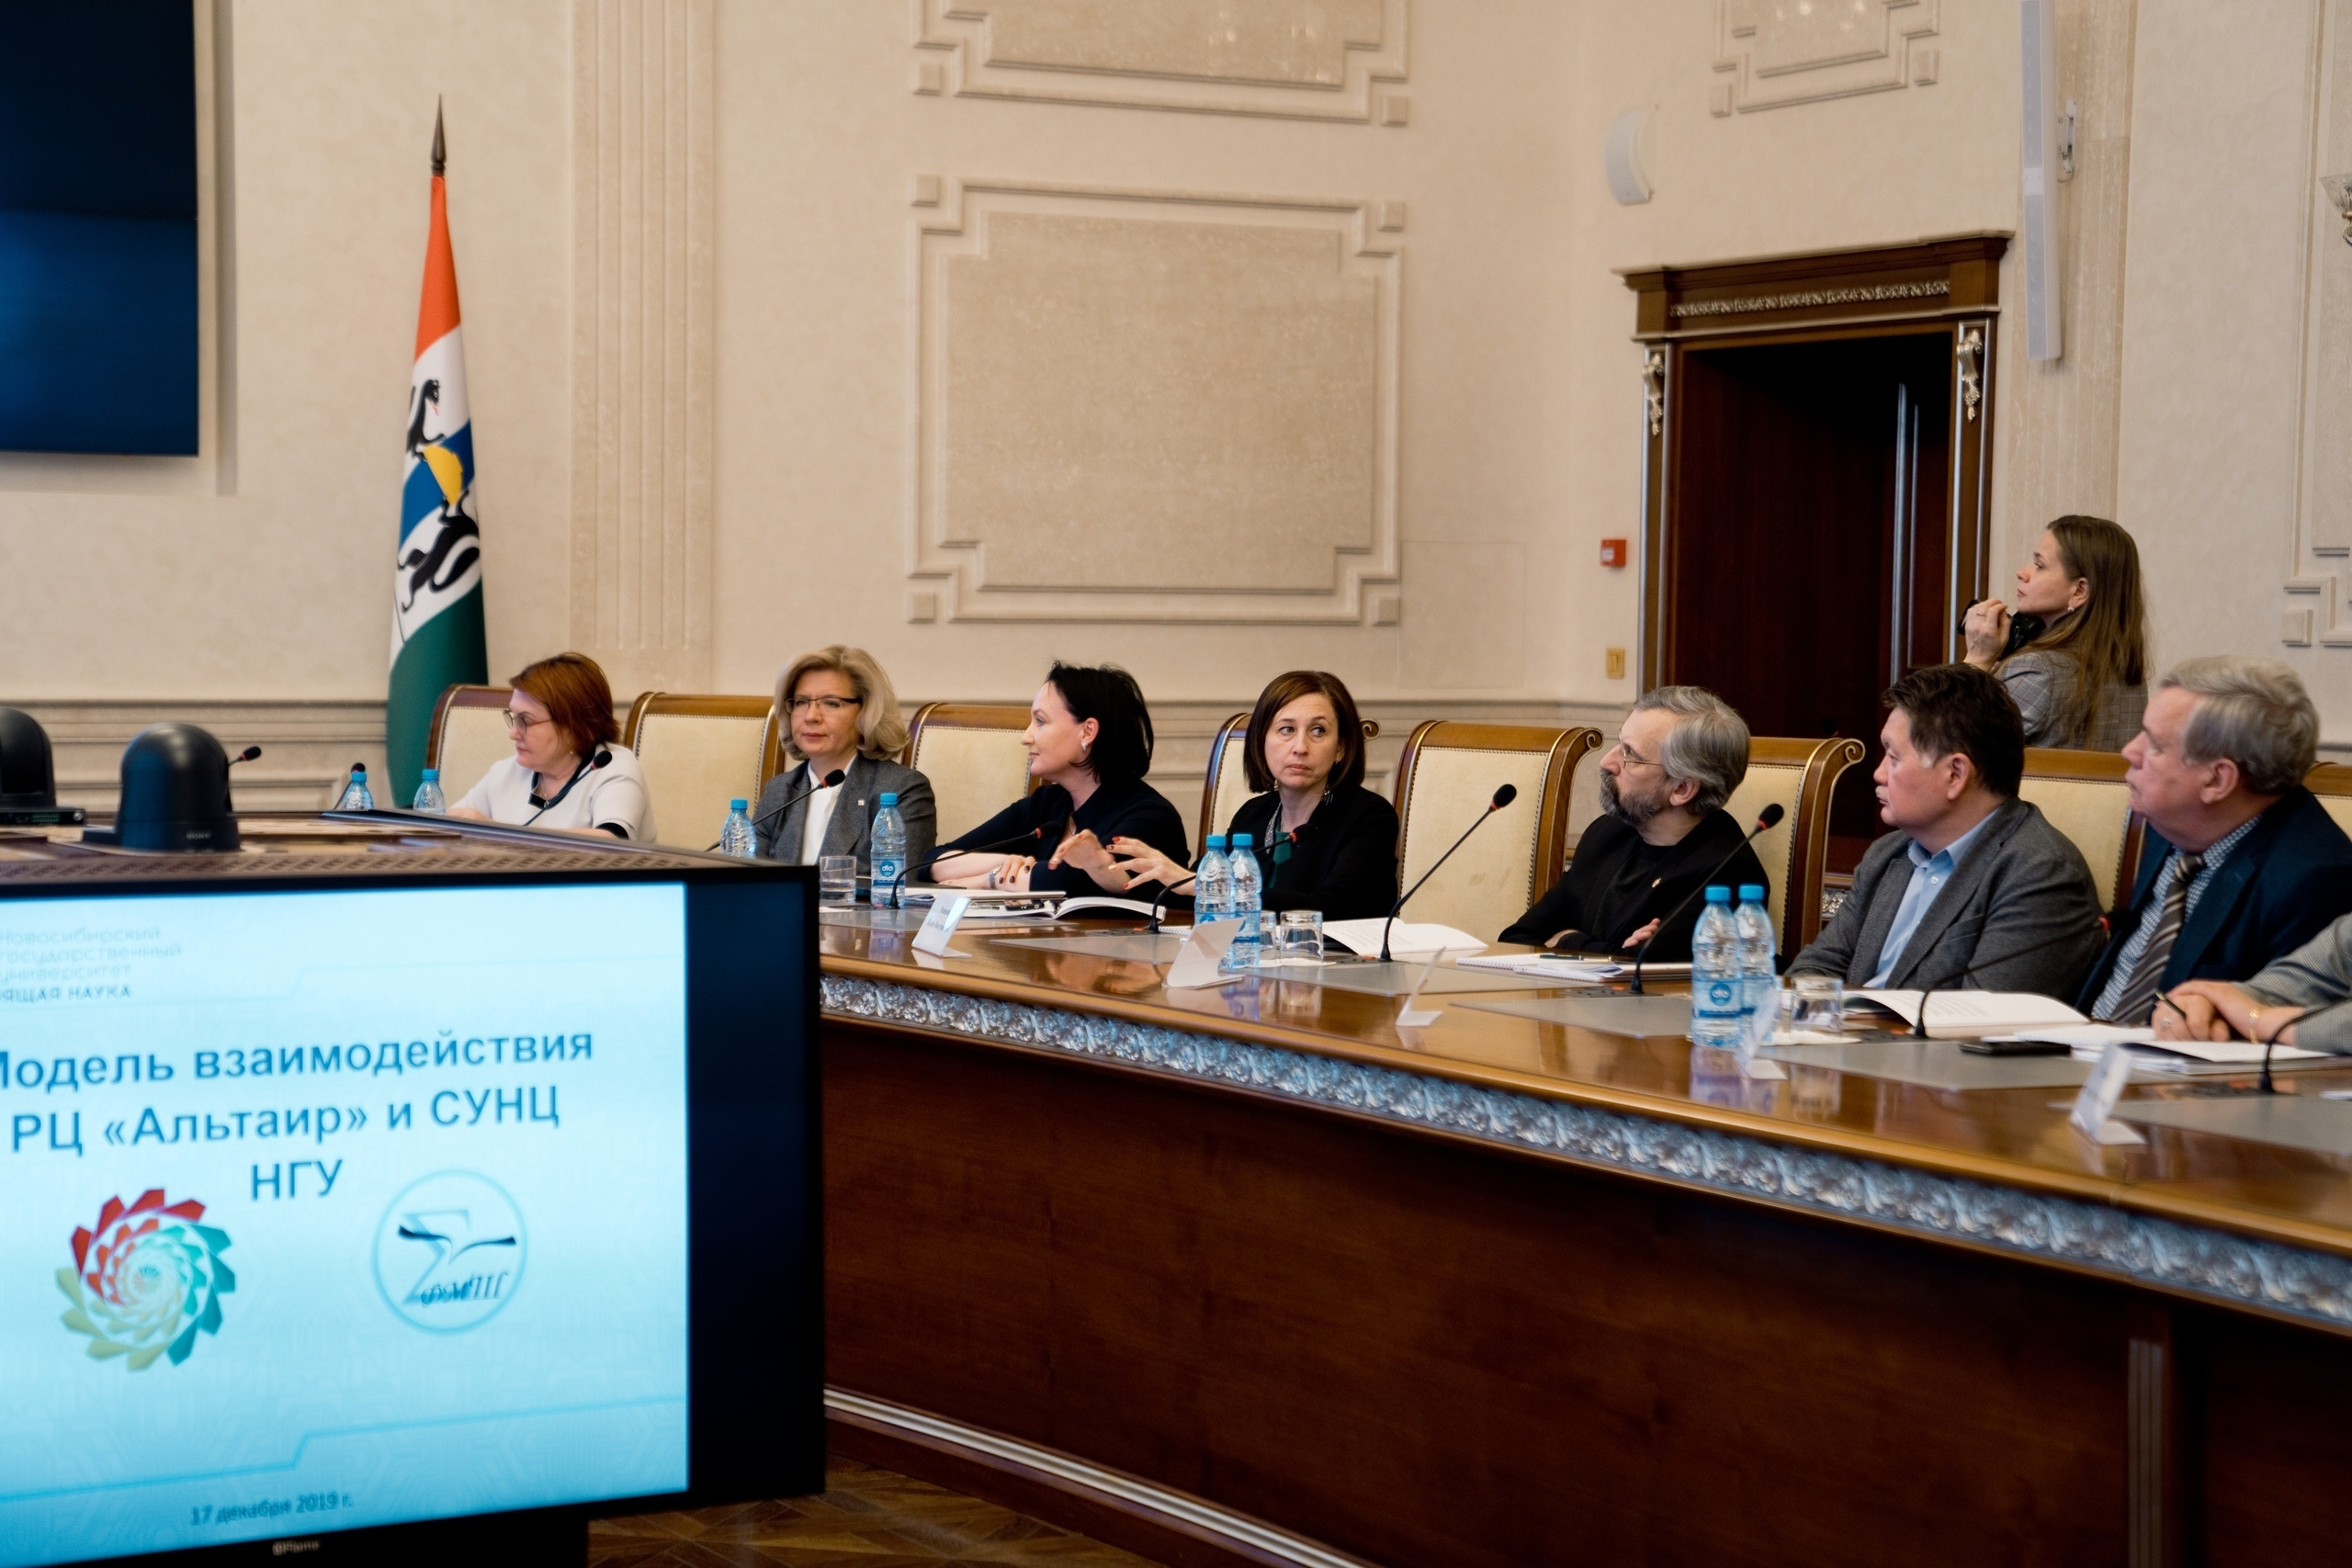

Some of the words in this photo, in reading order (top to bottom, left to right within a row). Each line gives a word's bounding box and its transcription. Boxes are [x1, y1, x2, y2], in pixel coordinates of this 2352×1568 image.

[68, 984, 130, 1000] НАУКА
[193, 1029, 594, 1080] взаимодействия
[12, 1110, 84, 1157] РЦ
[102, 1105, 368, 1146] «Альтаир»
[387, 1102, 412, 1130] и
[430, 1085, 560, 1129] СУНЦ
[251, 1158, 344, 1200] НГУ
[189, 1505, 214, 1527] 17
[215, 1498, 292, 1526] декабря
[295, 1490, 340, 1514] 2019
